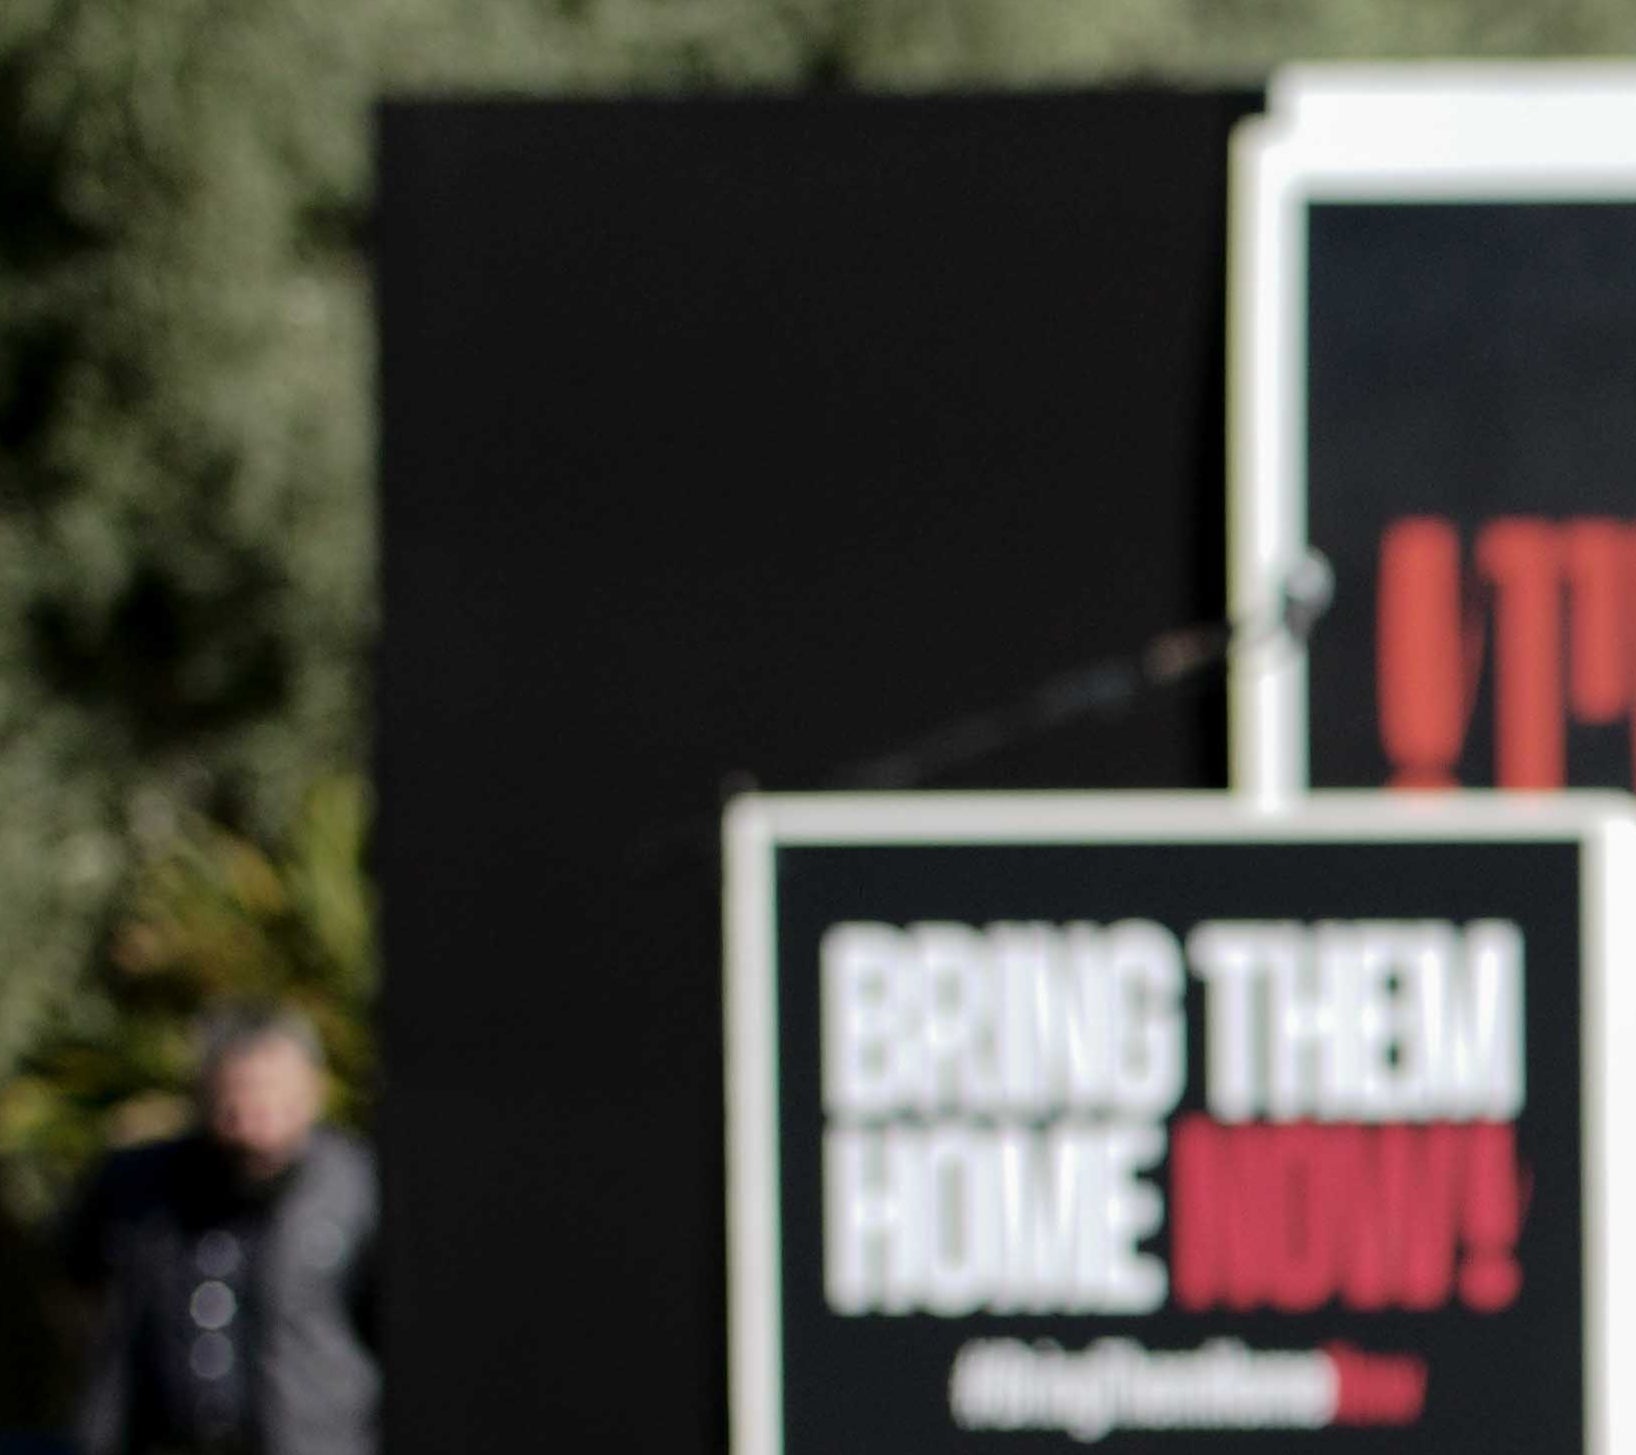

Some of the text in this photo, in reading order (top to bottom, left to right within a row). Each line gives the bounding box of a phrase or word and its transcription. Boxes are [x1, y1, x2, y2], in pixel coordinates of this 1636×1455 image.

[819, 918, 1526, 1124] BRING THEM
[823, 1112, 1533, 1317] HOME NOW!
